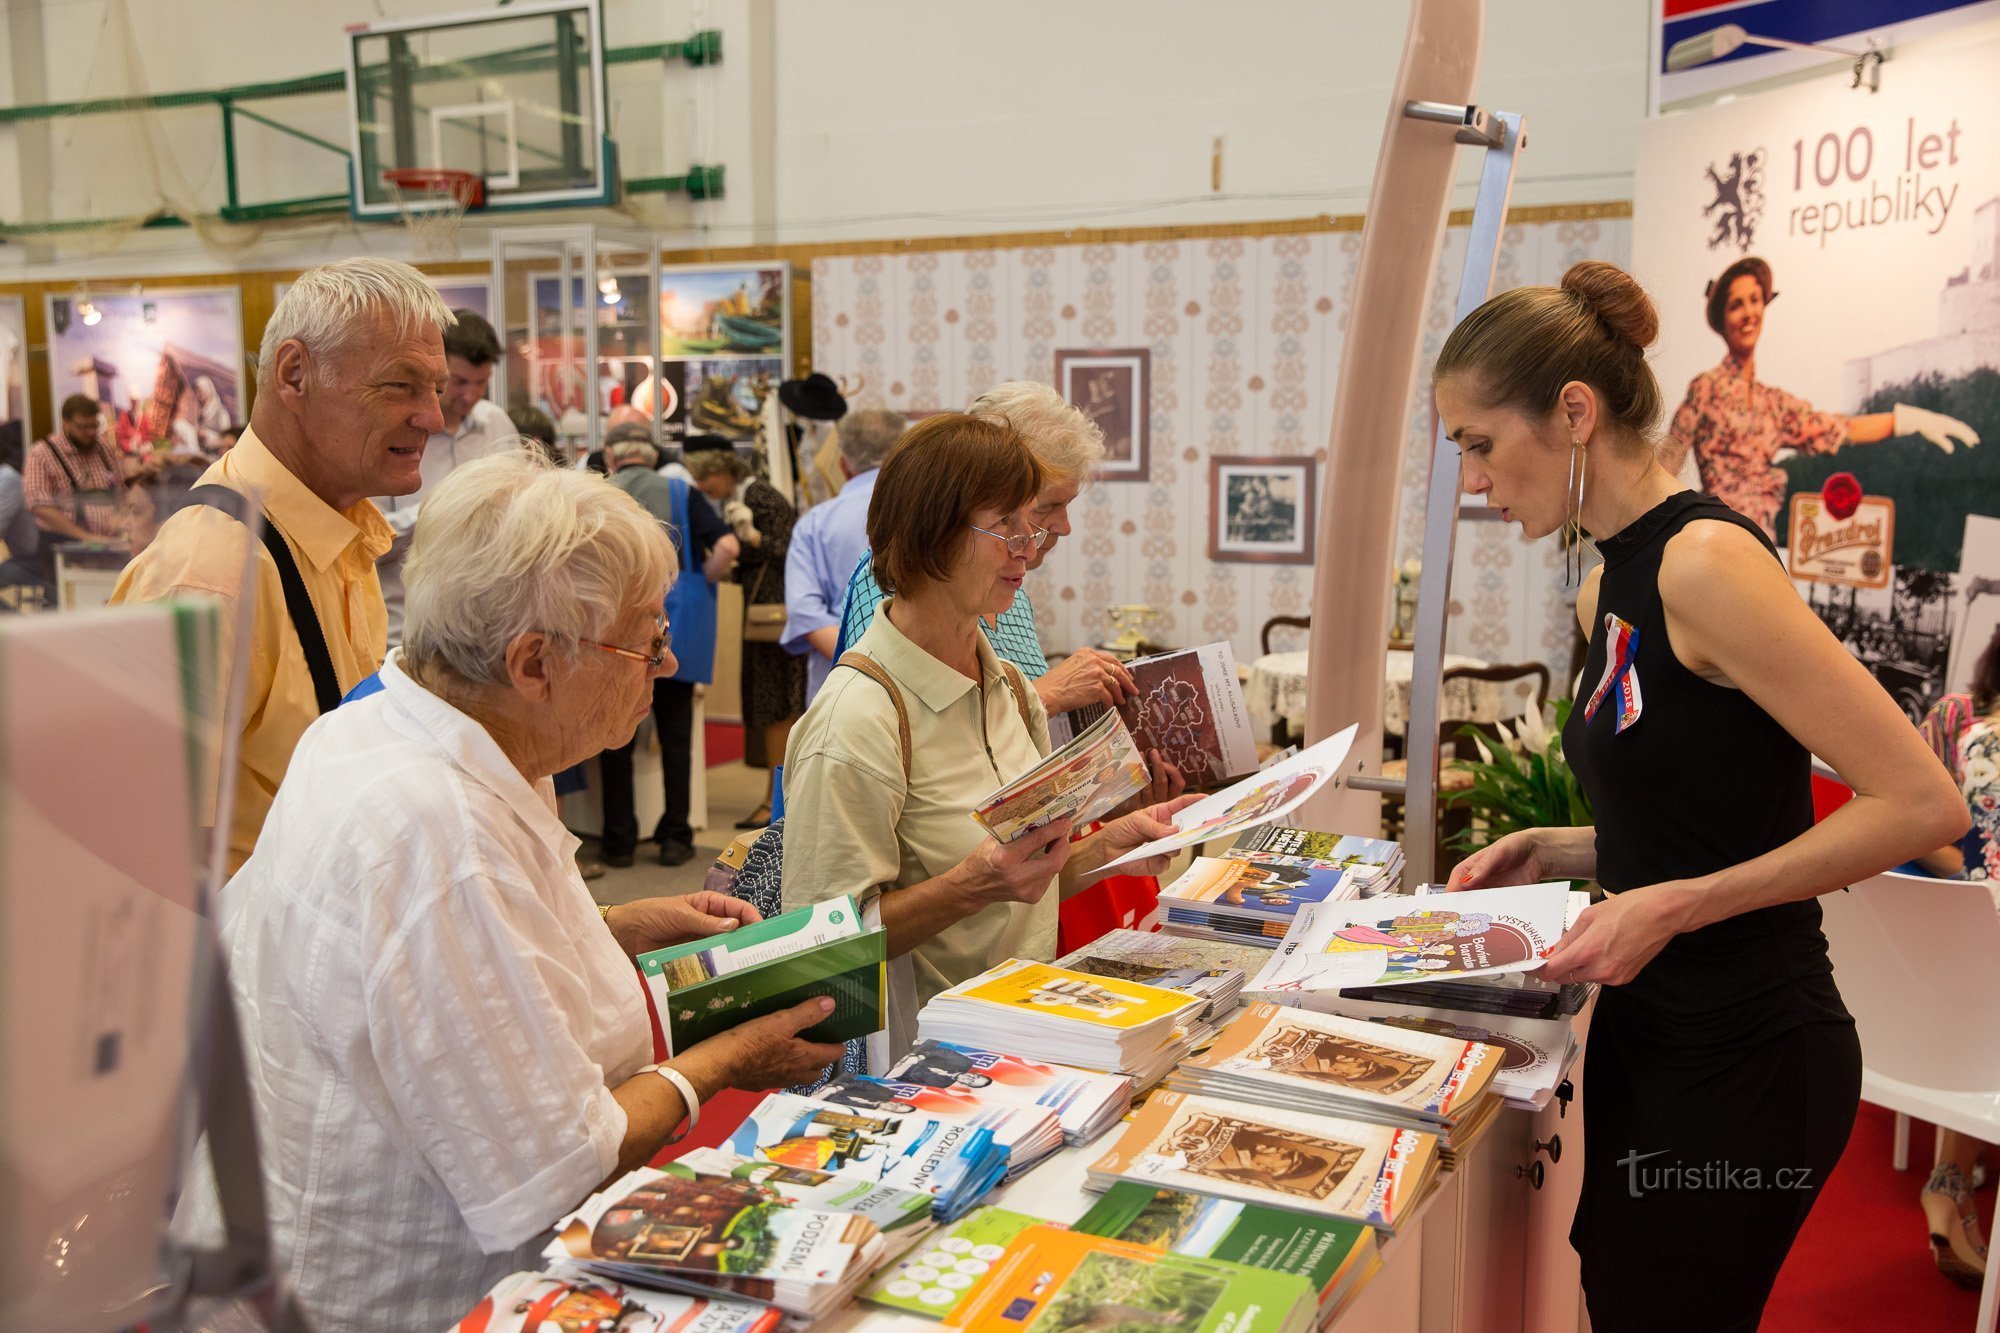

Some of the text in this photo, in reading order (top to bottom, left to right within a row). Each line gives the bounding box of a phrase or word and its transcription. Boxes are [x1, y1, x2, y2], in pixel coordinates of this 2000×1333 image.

[1791, 116, 1963, 193] 100 let
[1789, 173, 1959, 248] republiky
[1621, 680, 1633, 709] 2018
[1461, 1042, 1490, 1067] 100
[1393, 1129, 1422, 1154] 100
[908, 1125, 965, 1191] ROZHLEDNY
[848, 1187, 899, 1212] MUZEA
